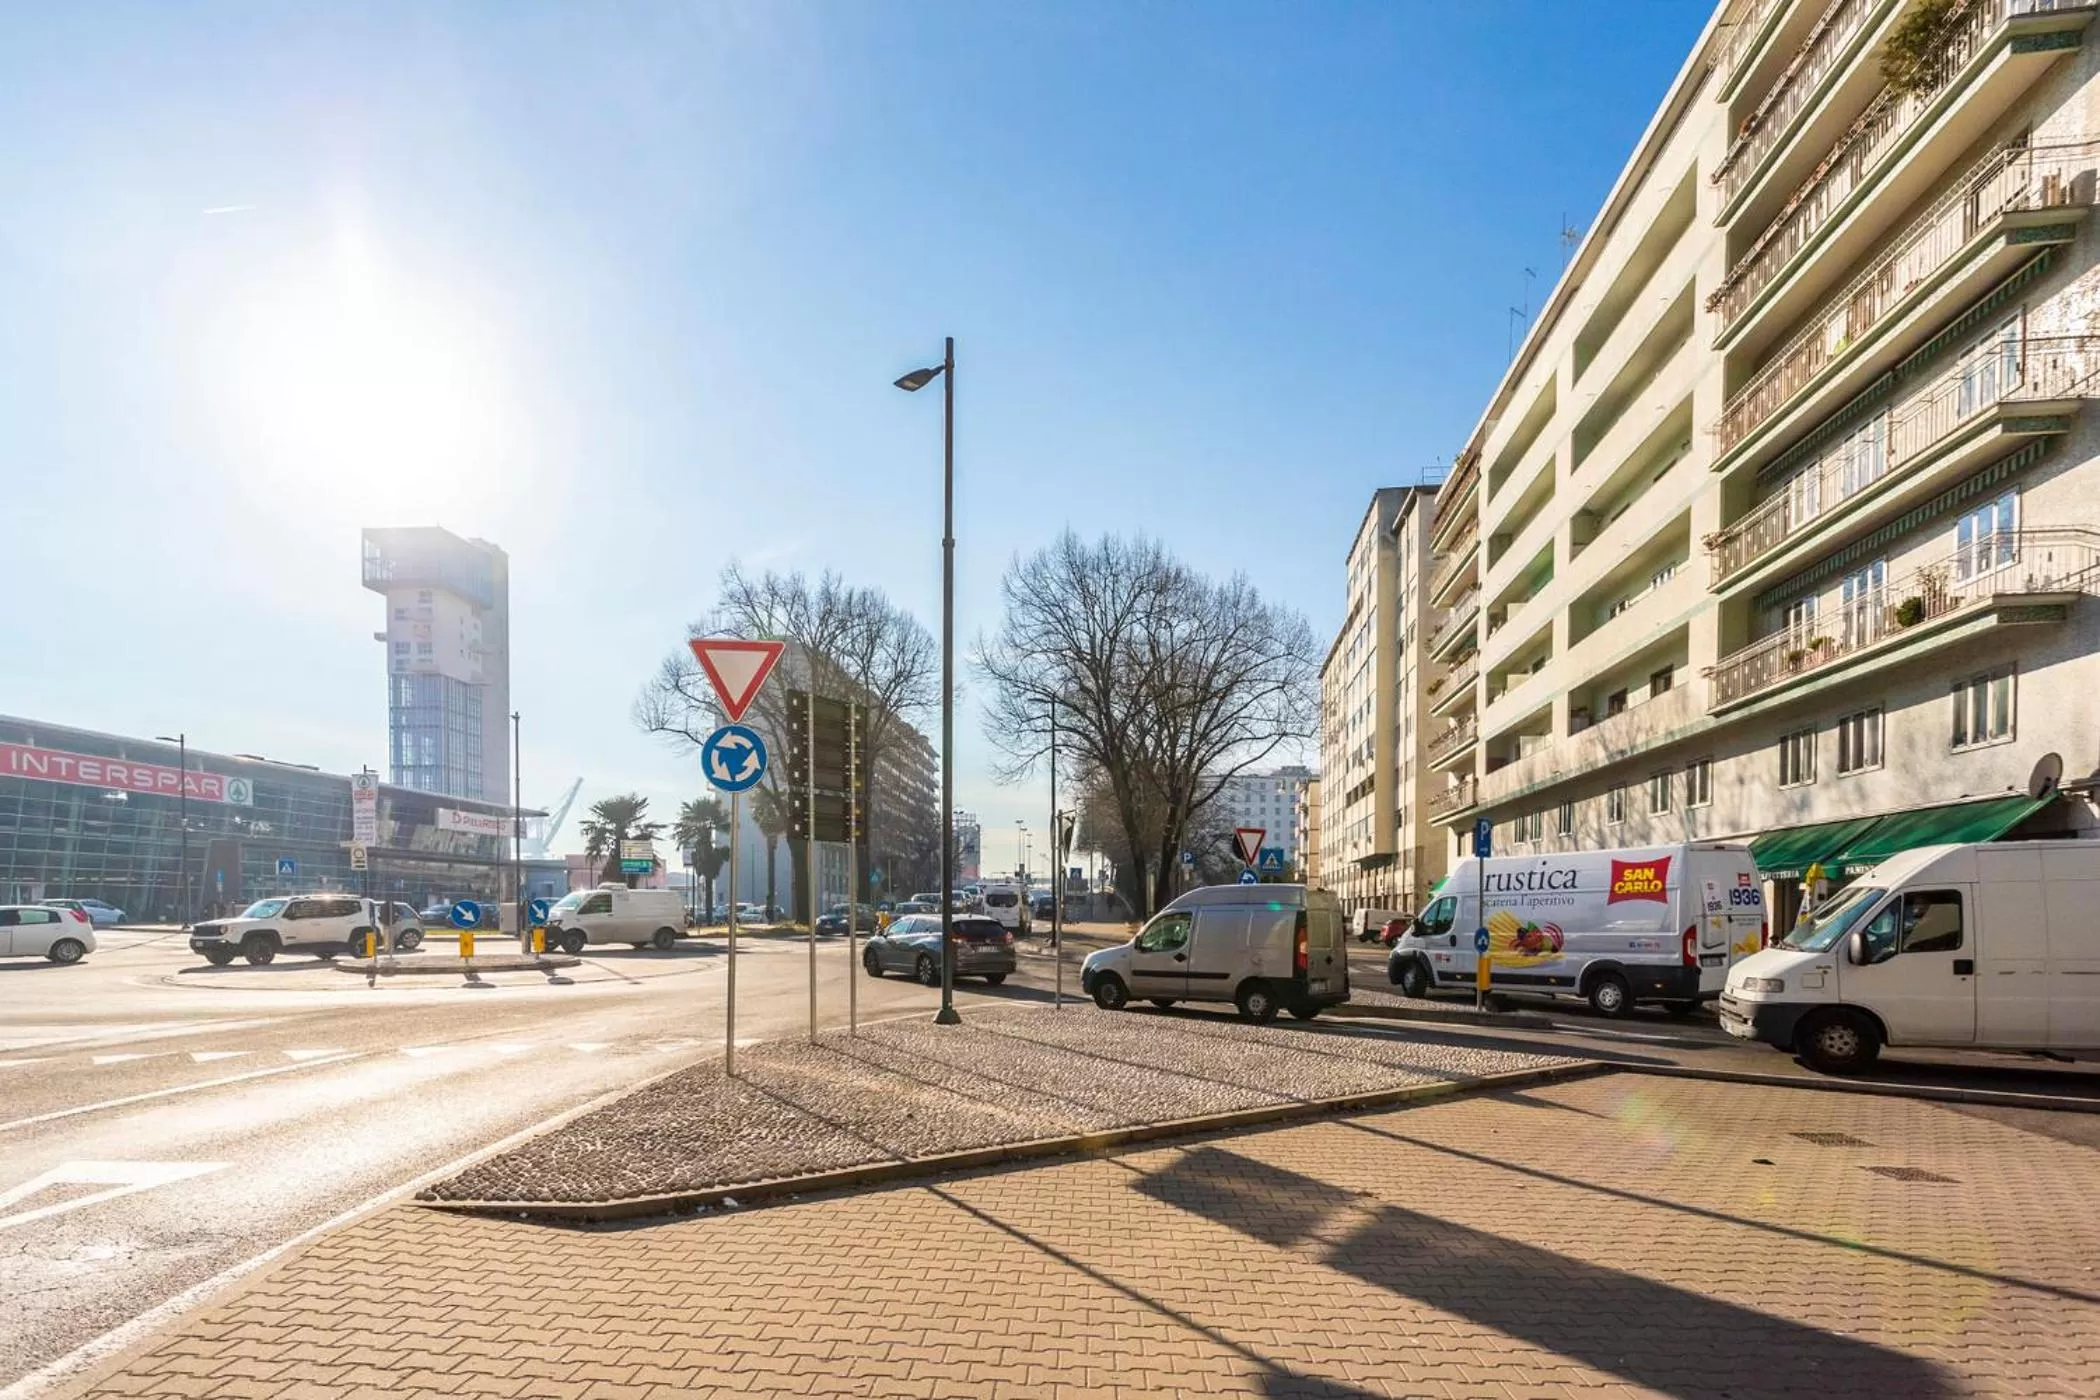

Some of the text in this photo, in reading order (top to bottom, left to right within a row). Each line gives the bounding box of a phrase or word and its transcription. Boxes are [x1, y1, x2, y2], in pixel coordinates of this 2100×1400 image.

[10, 750, 220, 797] INTERSPAR
[1480, 821, 1489, 841] P
[1183, 852, 1192, 865] P
[1484, 860, 1579, 893] rustica
[1623, 867, 1656, 881] SAN
[1613, 880, 1663, 895] CARLO
[1729, 888, 1761, 906] 1936
